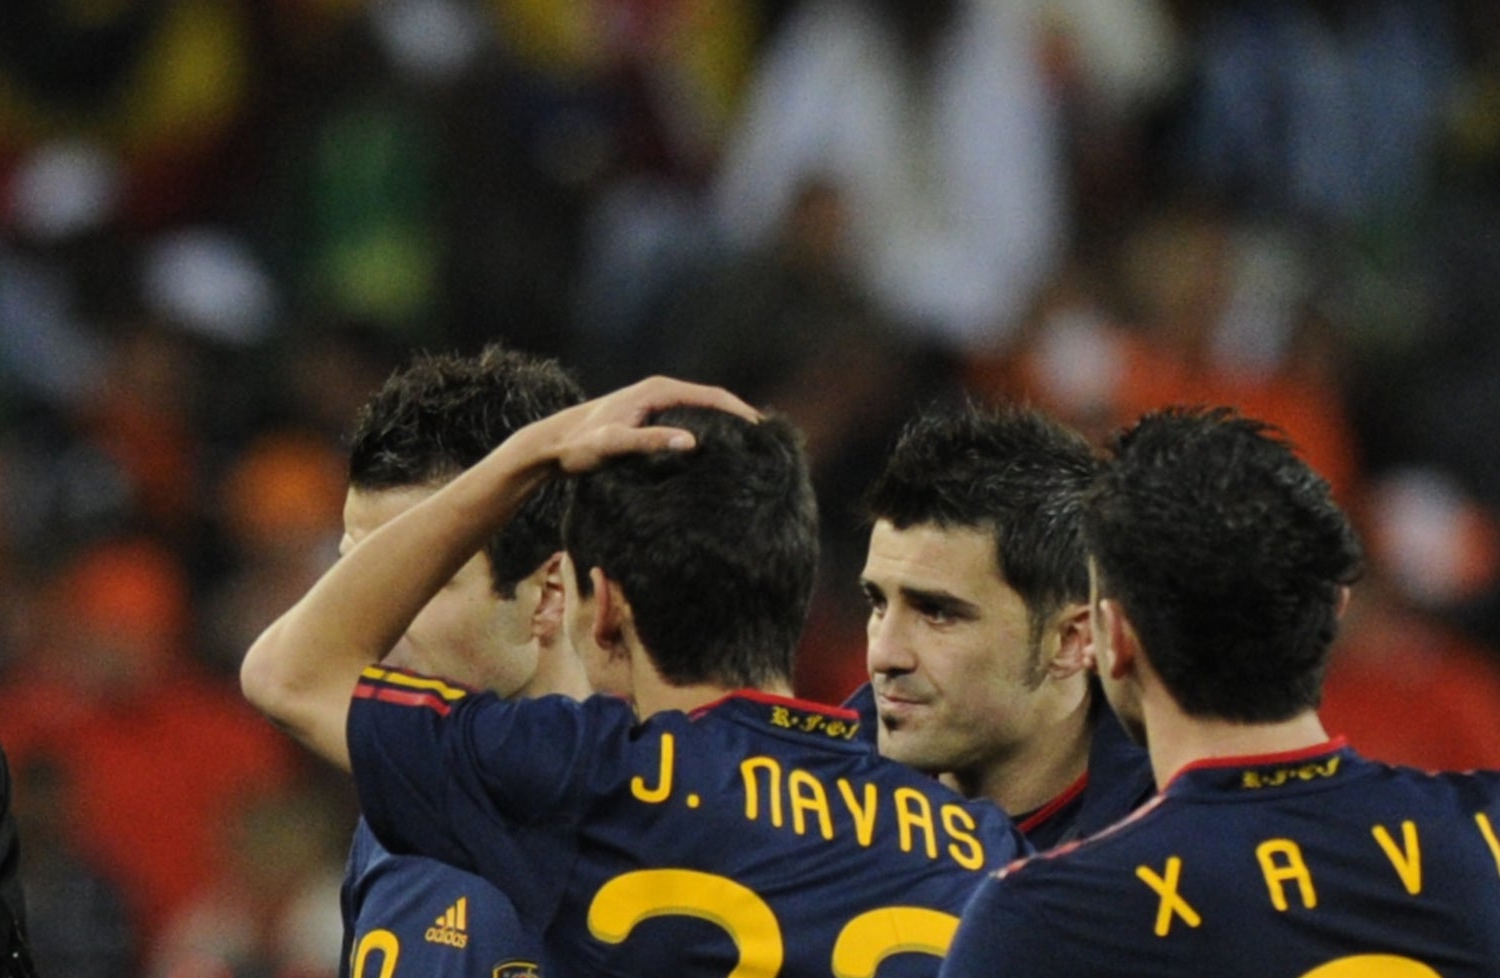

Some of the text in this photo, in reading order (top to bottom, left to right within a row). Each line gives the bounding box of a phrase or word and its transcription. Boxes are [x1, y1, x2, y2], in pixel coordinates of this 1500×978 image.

[630, 732, 985, 871] J. NAVAS
[424, 926, 469, 949] adidas
